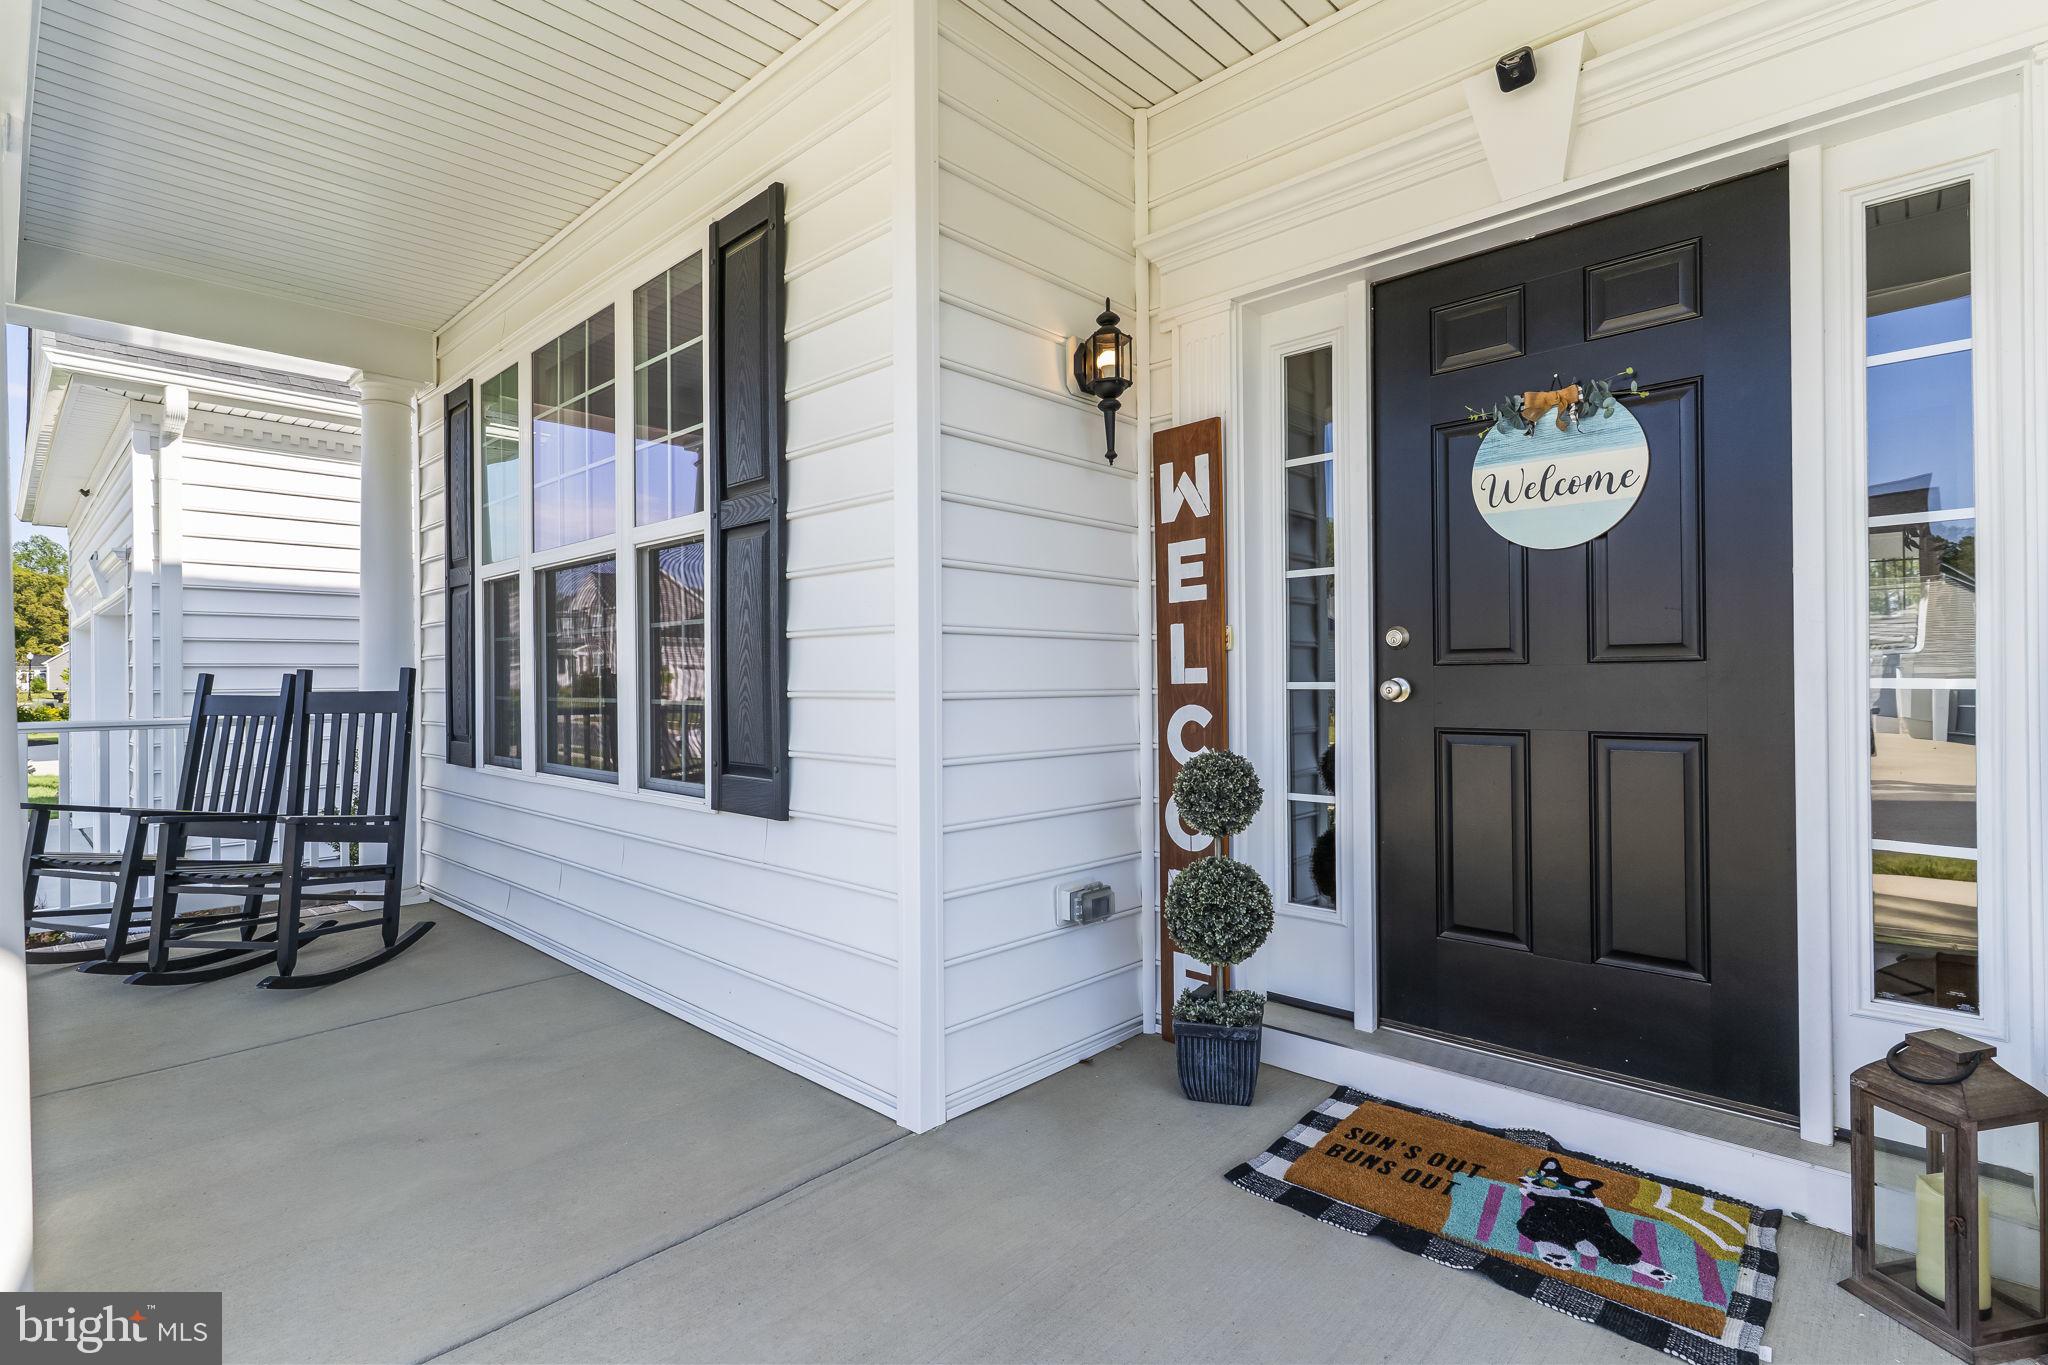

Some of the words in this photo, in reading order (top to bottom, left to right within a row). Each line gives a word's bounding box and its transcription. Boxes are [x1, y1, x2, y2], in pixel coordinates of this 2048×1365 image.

[1480, 464, 1641, 509] Welcome
[1325, 1143, 1397, 1175] BUNS
[1400, 1168, 1461, 1195] OUT
[1344, 1126, 1422, 1160] SUN'S
[1427, 1152, 1487, 1178] OUT
